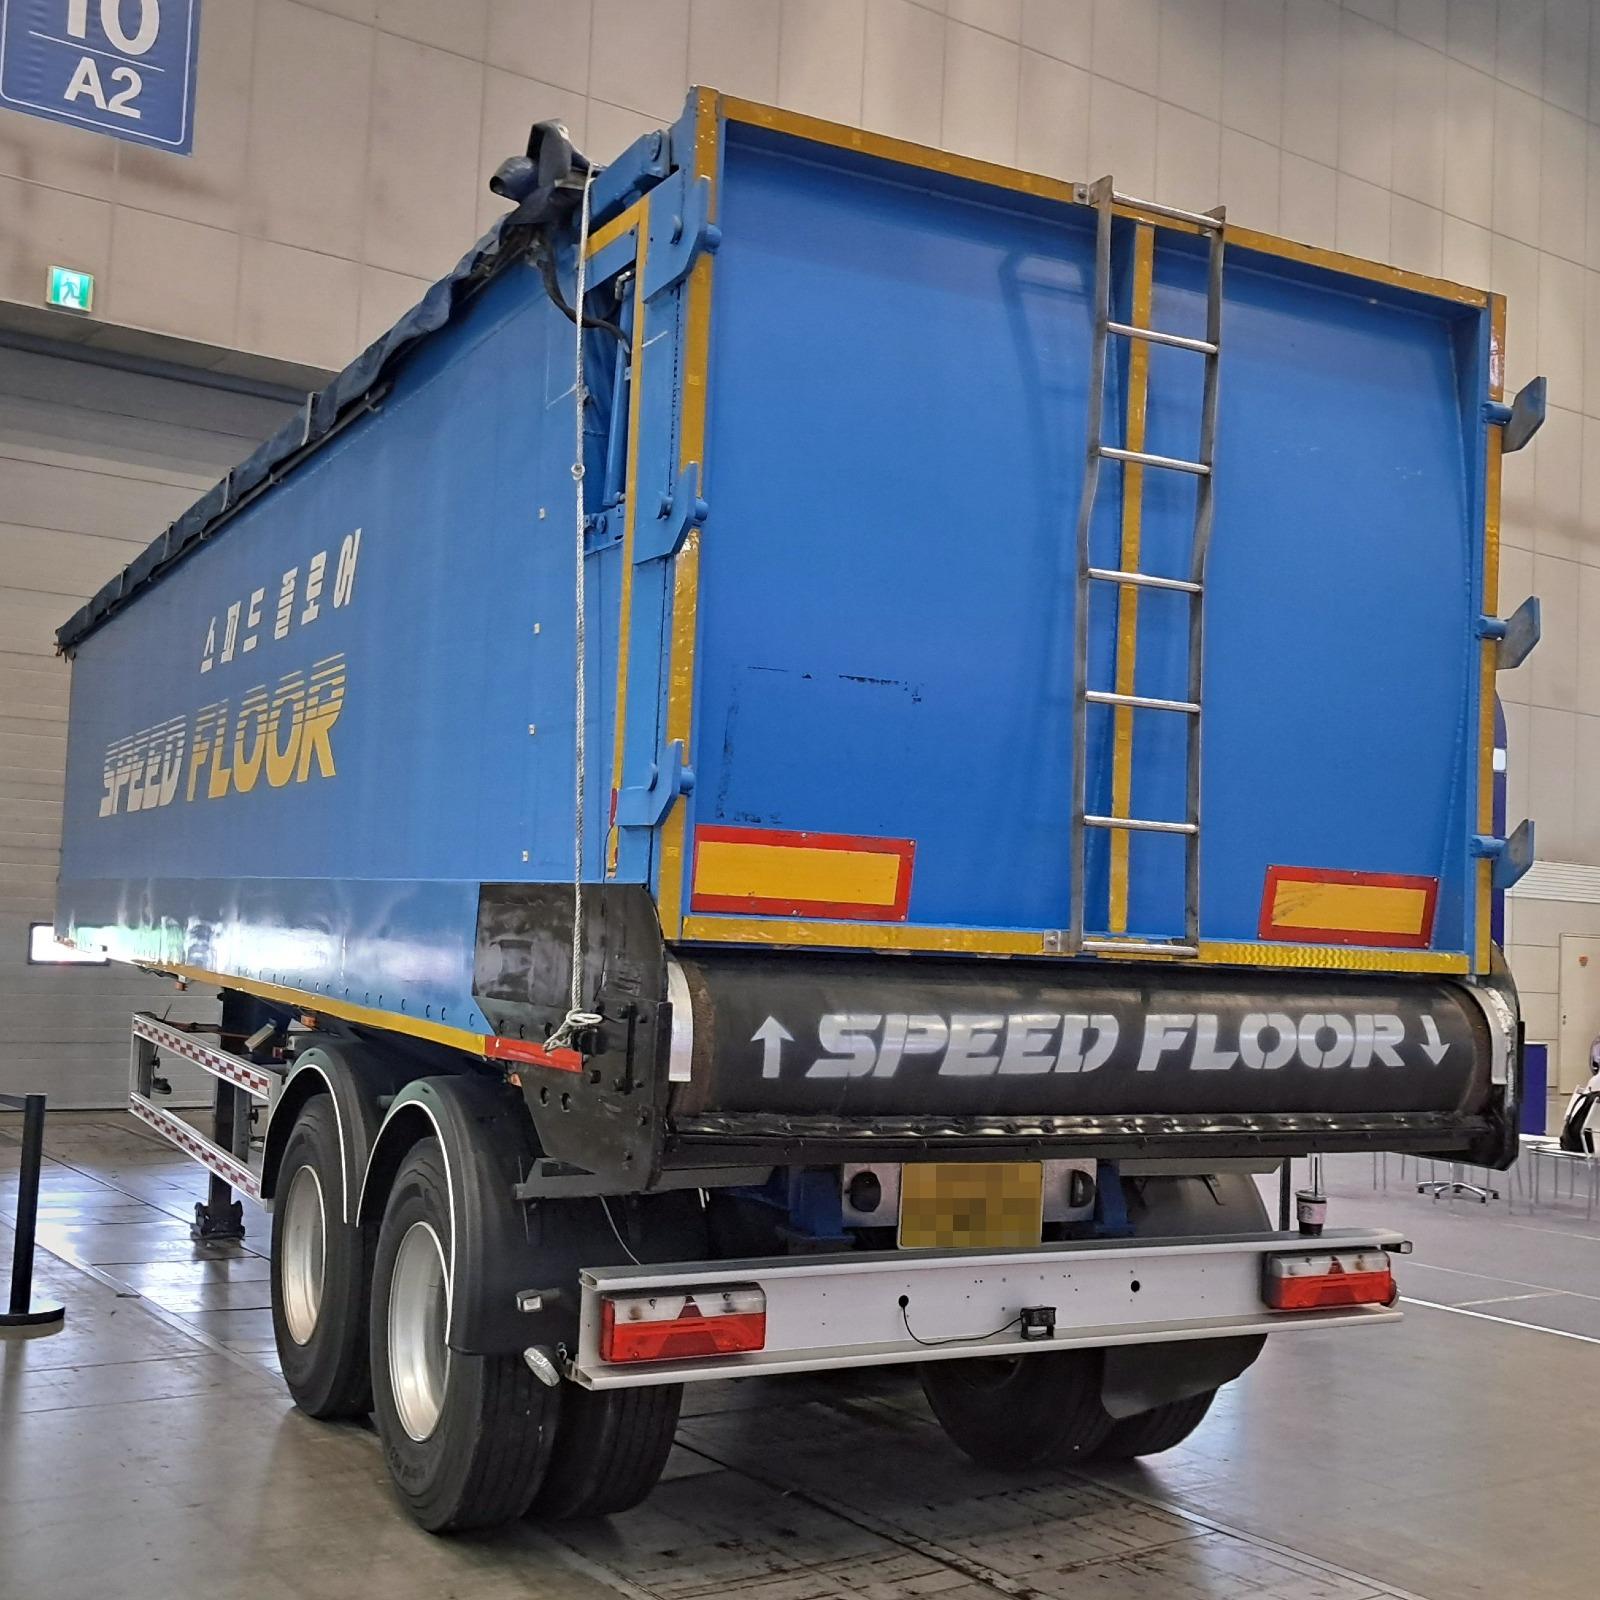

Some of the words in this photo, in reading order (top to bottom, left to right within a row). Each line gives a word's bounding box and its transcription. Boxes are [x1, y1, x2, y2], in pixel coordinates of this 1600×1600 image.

[64, 56, 142, 119] A2
[99, 714, 186, 817] SPEED
[187, 653, 346, 802] FLOOR
[805, 1013, 1119, 1077] SPEED
[1137, 1013, 1405, 1071] FLOOR
